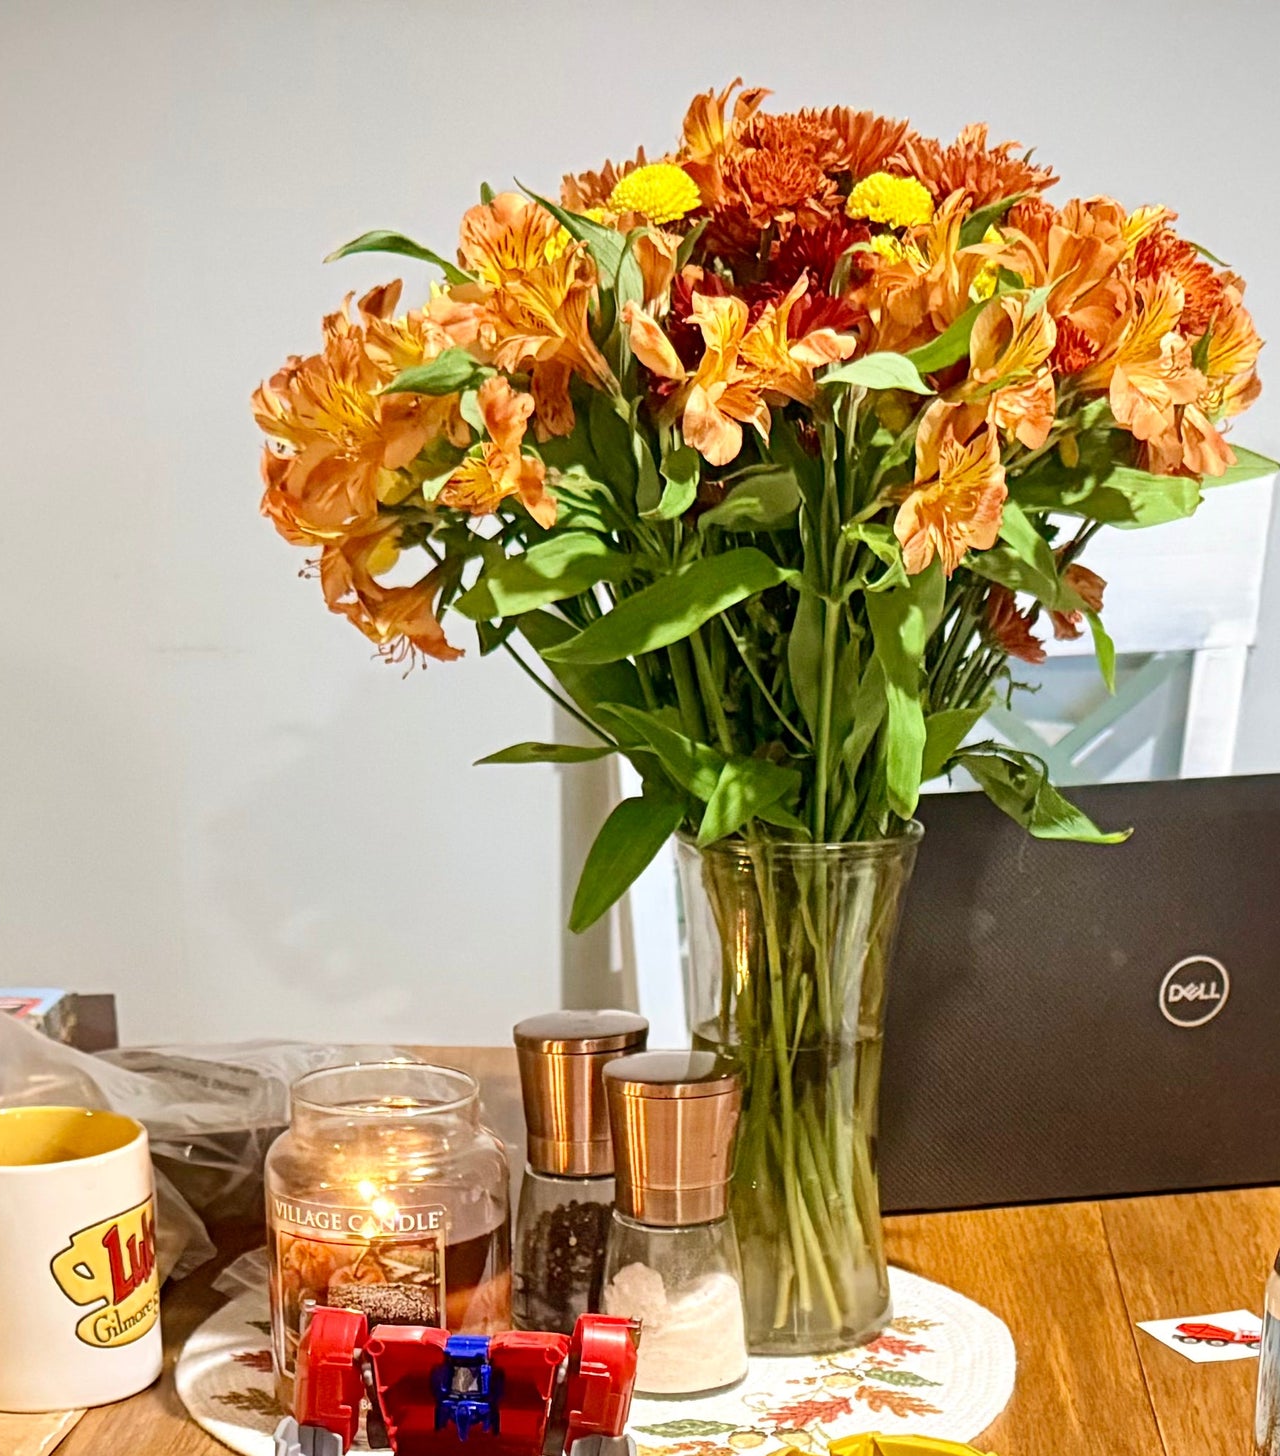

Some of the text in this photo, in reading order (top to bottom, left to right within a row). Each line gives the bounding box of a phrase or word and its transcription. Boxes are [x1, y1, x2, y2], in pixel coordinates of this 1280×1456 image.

[1168, 981, 1220, 1003] DELL
[275, 1200, 440, 1233] VILLAGE CANDLE
[93, 1308, 153, 1343] Gilmore
